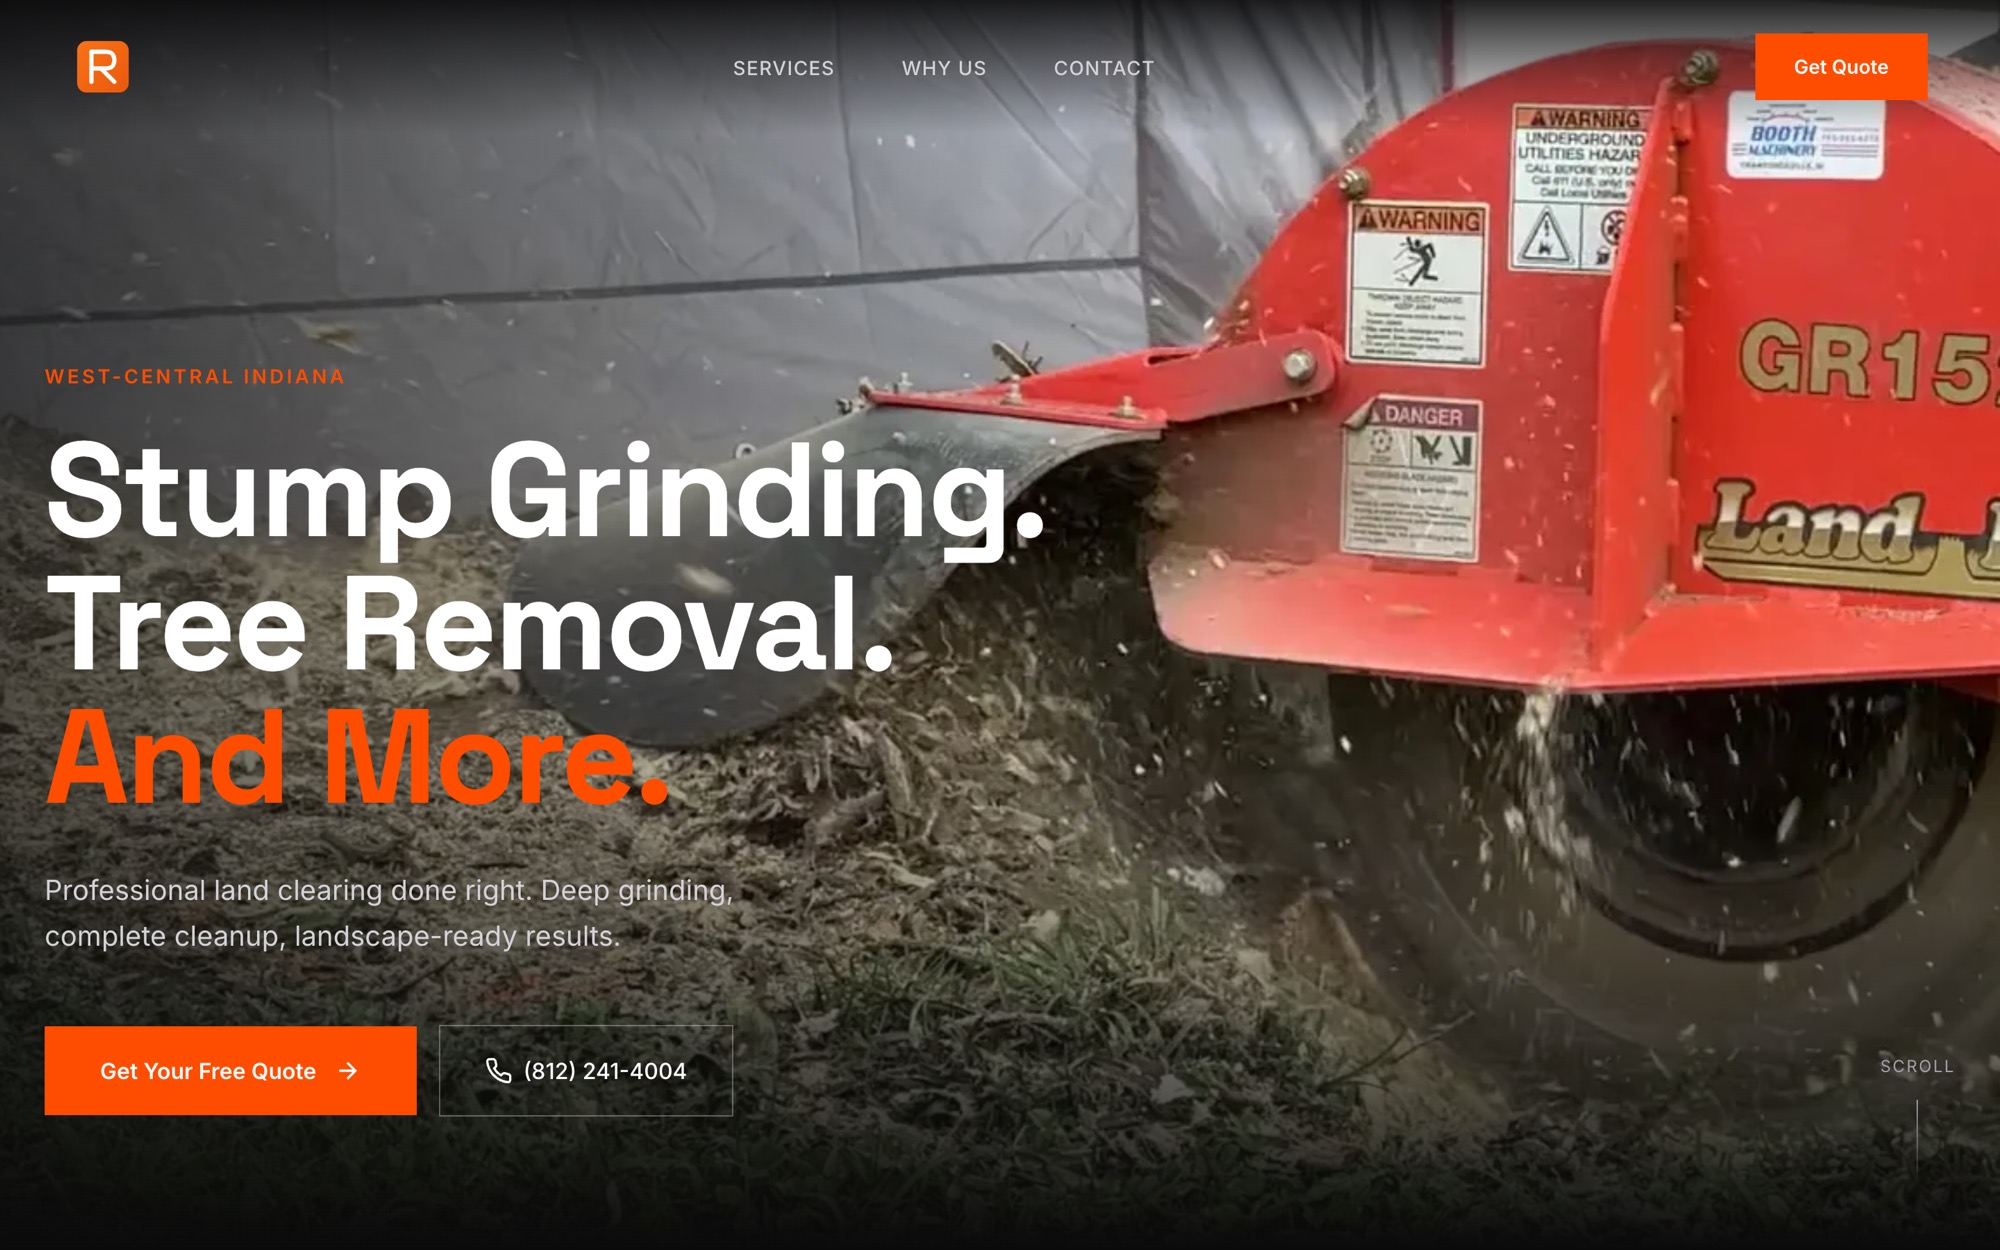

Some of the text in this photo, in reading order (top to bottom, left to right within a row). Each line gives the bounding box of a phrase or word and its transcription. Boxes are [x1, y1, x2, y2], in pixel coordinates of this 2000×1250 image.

[1550, 111, 1640, 128] WARNING
[1525, 132, 1645, 147] UNDERGROUND
[1751, 125, 1817, 142] BOOTH
[1518, 147, 1641, 162] UTILITIES HAZAR
[1748, 144, 1817, 157] MACHINERY
[1525, 163, 1551, 174] CALL
[1378, 209, 1480, 231] WARNING
[1740, 318, 2000, 407] GR15
[1385, 405, 1463, 427] DANGER
[1704, 477, 1926, 565] Land
